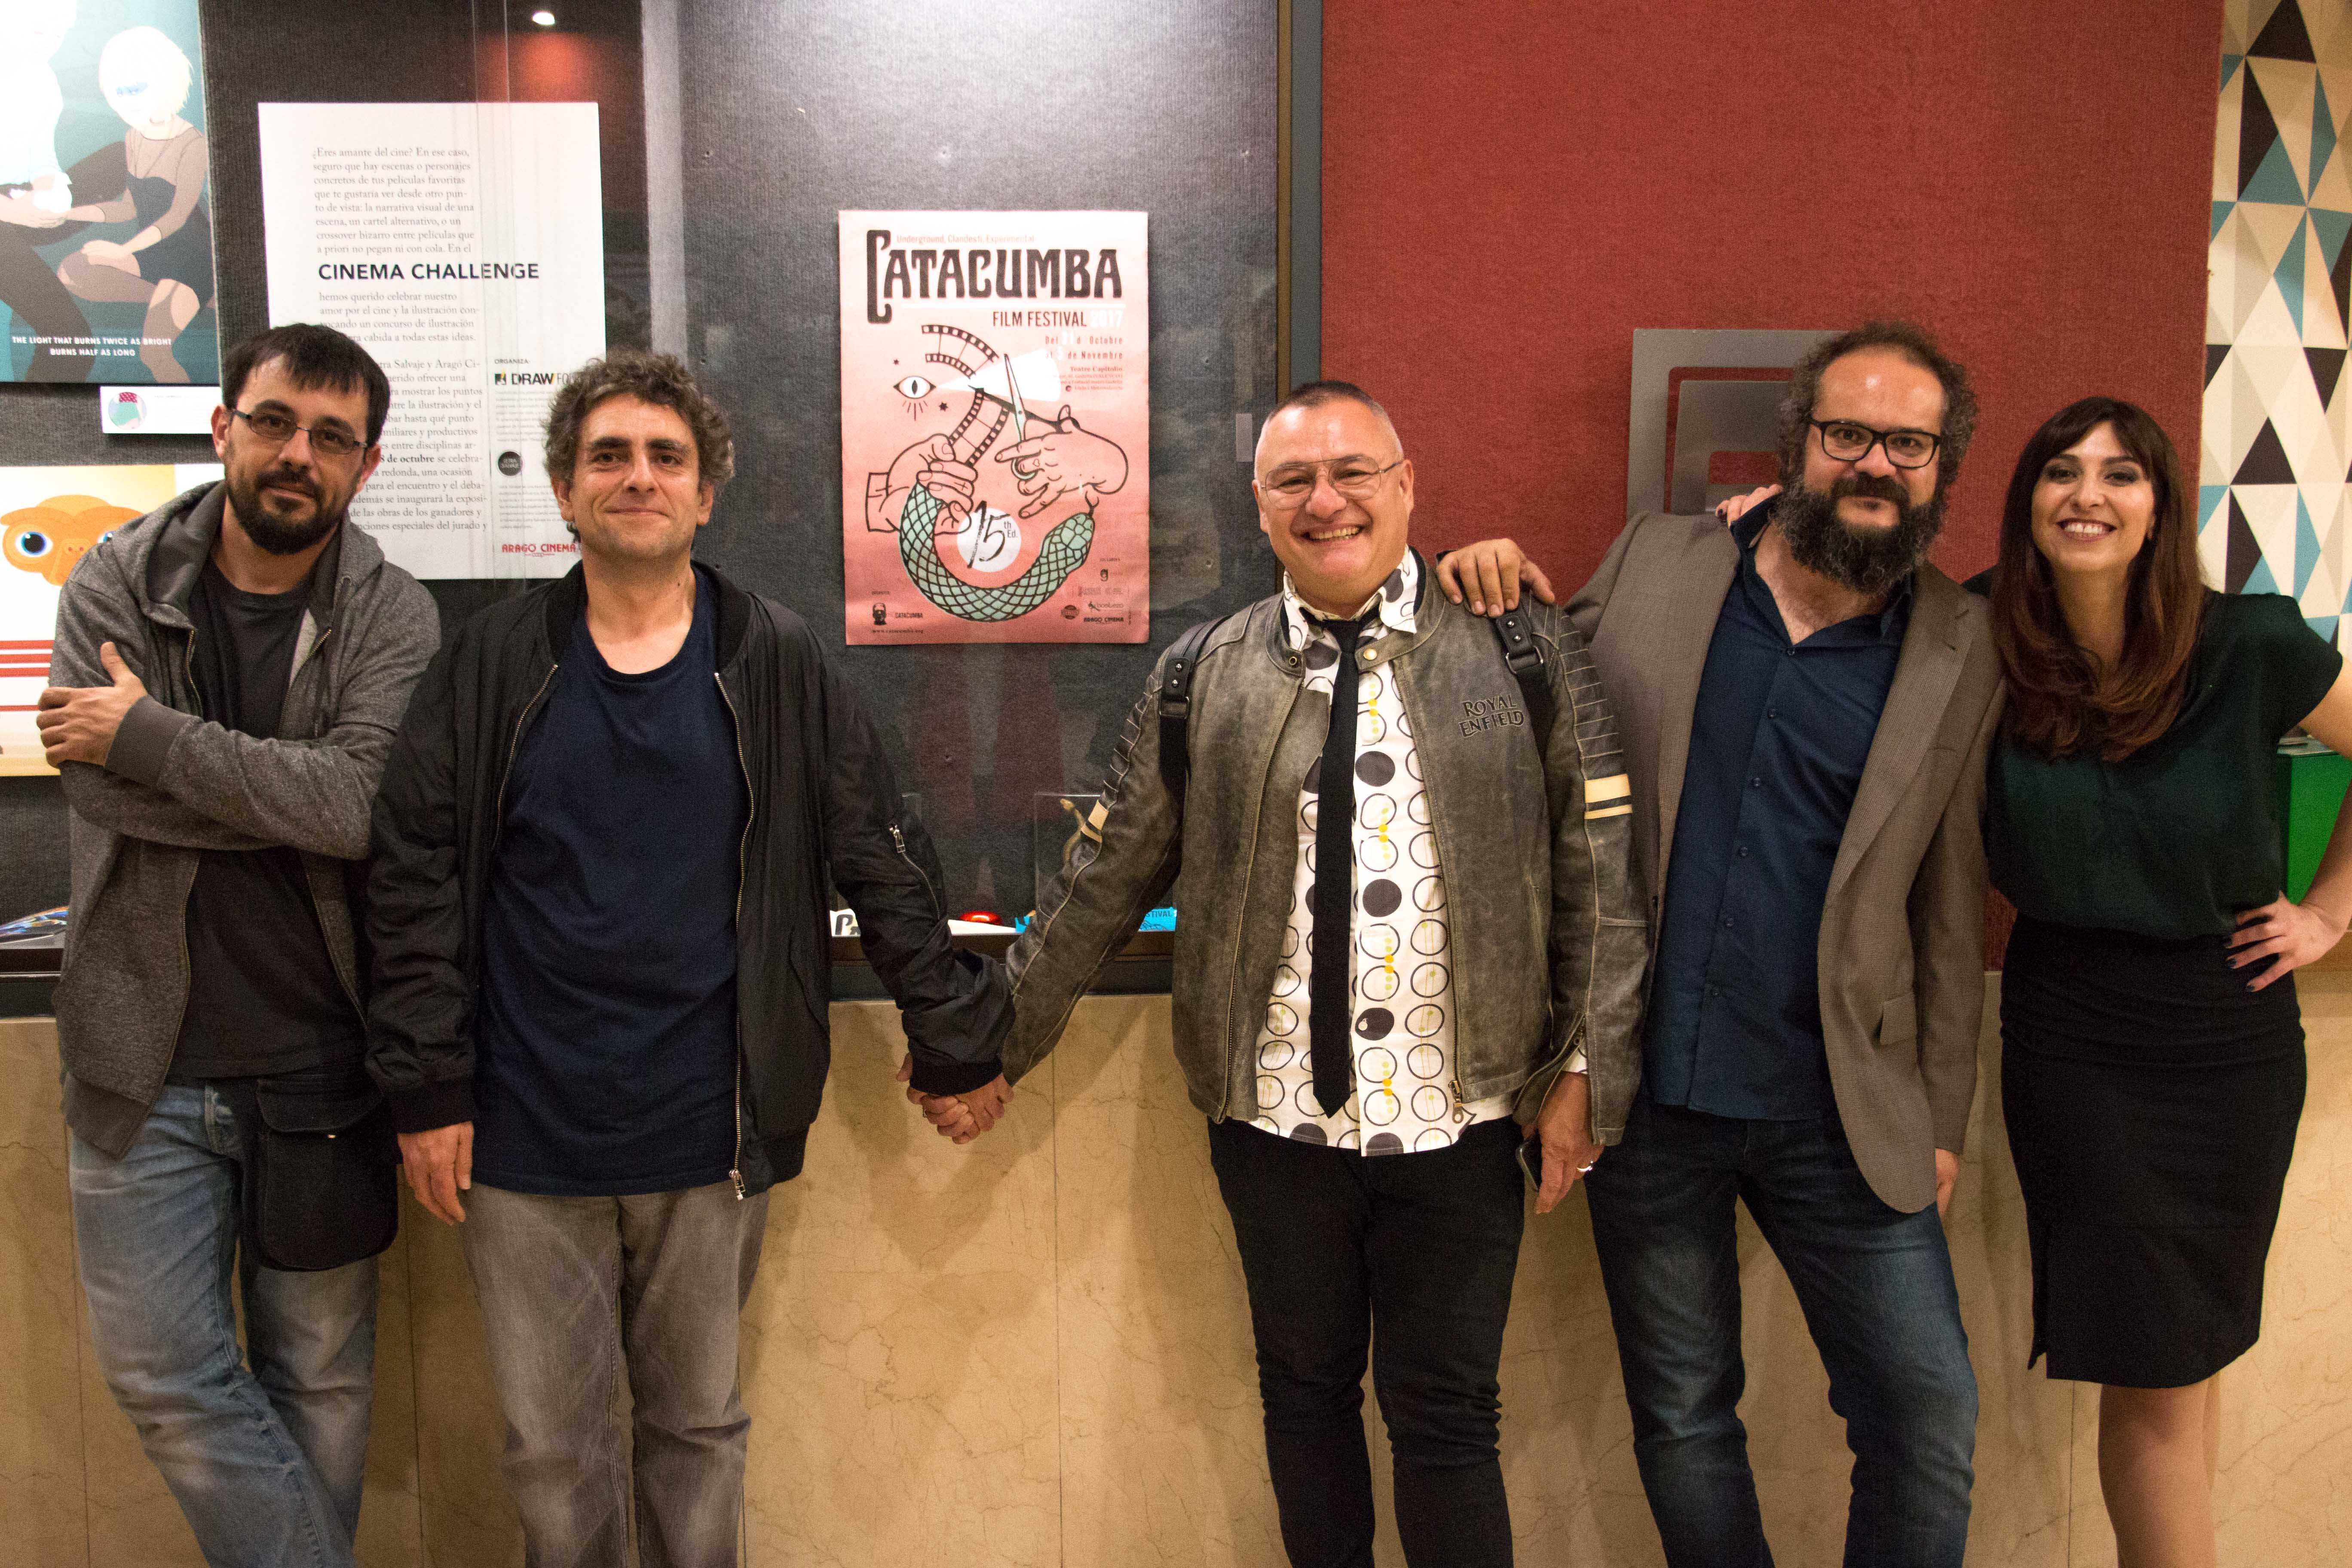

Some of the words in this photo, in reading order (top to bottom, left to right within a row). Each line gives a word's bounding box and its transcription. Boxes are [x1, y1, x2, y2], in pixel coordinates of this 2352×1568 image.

[312, 147, 337, 159] ¿Eres
[374, 147, 388, 156] del
[390, 147, 413, 156] cine?
[416, 147, 429, 156] En
[313, 164, 342, 173] seguro
[344, 164, 360, 173] que
[363, 161, 378, 172] hay
[425, 163, 471, 173] personajes
[358, 175, 369, 184] de
[428, 176, 465, 184] favoritas
[314, 191, 330, 201] que
[397, 188, 422, 198] desde
[446, 191, 467, 200] pun-
[327, 202, 337, 212] de
[340, 204, 362, 212] vista:
[365, 202, 373, 212] la
[375, 203, 414, 212] narrativa
[417, 202, 442, 212] visual
[444, 202, 455, 211] de
[363, 216, 387, 226] cartel
[390, 216, 439, 226] alternativo,
[359, 230, 390, 239] bizarro
[458, 232, 475, 242] que
[324, 247, 349, 256] priori
[366, 246, 392, 256] pegan
[425, 243, 445, 253] cola.
[448, 243, 461, 253] En
[318, 263, 404, 280] CINEMA
[411, 263, 539, 280] CHALLENGE
[867, 230, 1123, 324] CATACUMBA
[319, 291, 348, 301] hemos
[350, 291, 385, 303] querido
[387, 291, 421, 301] celebrar
[345, 308, 360, 317] por
[401, 305, 409, 314] la
[411, 305, 457, 314] ilustración
[415, 318, 425, 328] de
[429, 318, 474, 328] ilustración
[992, 311, 1025, 328] FILM
[1027, 311, 1087, 327] FESTIVAL
[1090, 310, 1123, 328] 2017
[364, 332, 392, 342] cabida
[402, 332, 426, 341] todas
[452, 332, 476, 341] ideas.
[1045, 336, 1058, 344] Del
[1081, 350, 1123, 360] Novembre
[394, 359, 424, 369] Salvaje
[436, 359, 462, 370] Aragó
[464, 358, 480, 368] Ci-
[417, 373, 447, 382] ofrecer
[438, 386, 450, 395] los
[453, 388, 483, 398] puntos
[408, 400, 416, 409] la
[418, 400, 464, 409] ilustración
[404, 413, 427, 423] hasta
[429, 414, 445, 425] qué
[448, 415, 474, 425] punto
[427, 426, 478, 439] productivos
[416, 440, 462, 452] disciplinas
[386, 453, 398, 463] de
[400, 453, 435, 463] octubre
[448, 453, 484, 463] celebra-
[382, 467, 420, 477] redonda,
[366, 484, 384, 492] para
[460, 480, 484, 490] deba-
[397, 495, 443, 505] inaugurará
[446, 493, 453, 503] la
[456, 496, 486, 505] exposi-
[351, 508, 360, 517] de
[363, 508, 374, 517] las
[377, 508, 401, 517] obras
[402, 507, 413, 517] de
[416, 507, 428, 516] los
[431, 506, 474, 519] ganadores
[392, 521, 434, 533] especiales
[436, 520, 450, 530] del
[452, 520, 480, 532] jurado
[1007, 530, 1018, 538] Ed.
[540, 543, 576, 553] CINEMA
[1462, 694, 1519, 717] ROYAL
[1458, 710, 1525, 738] ENFIELD
